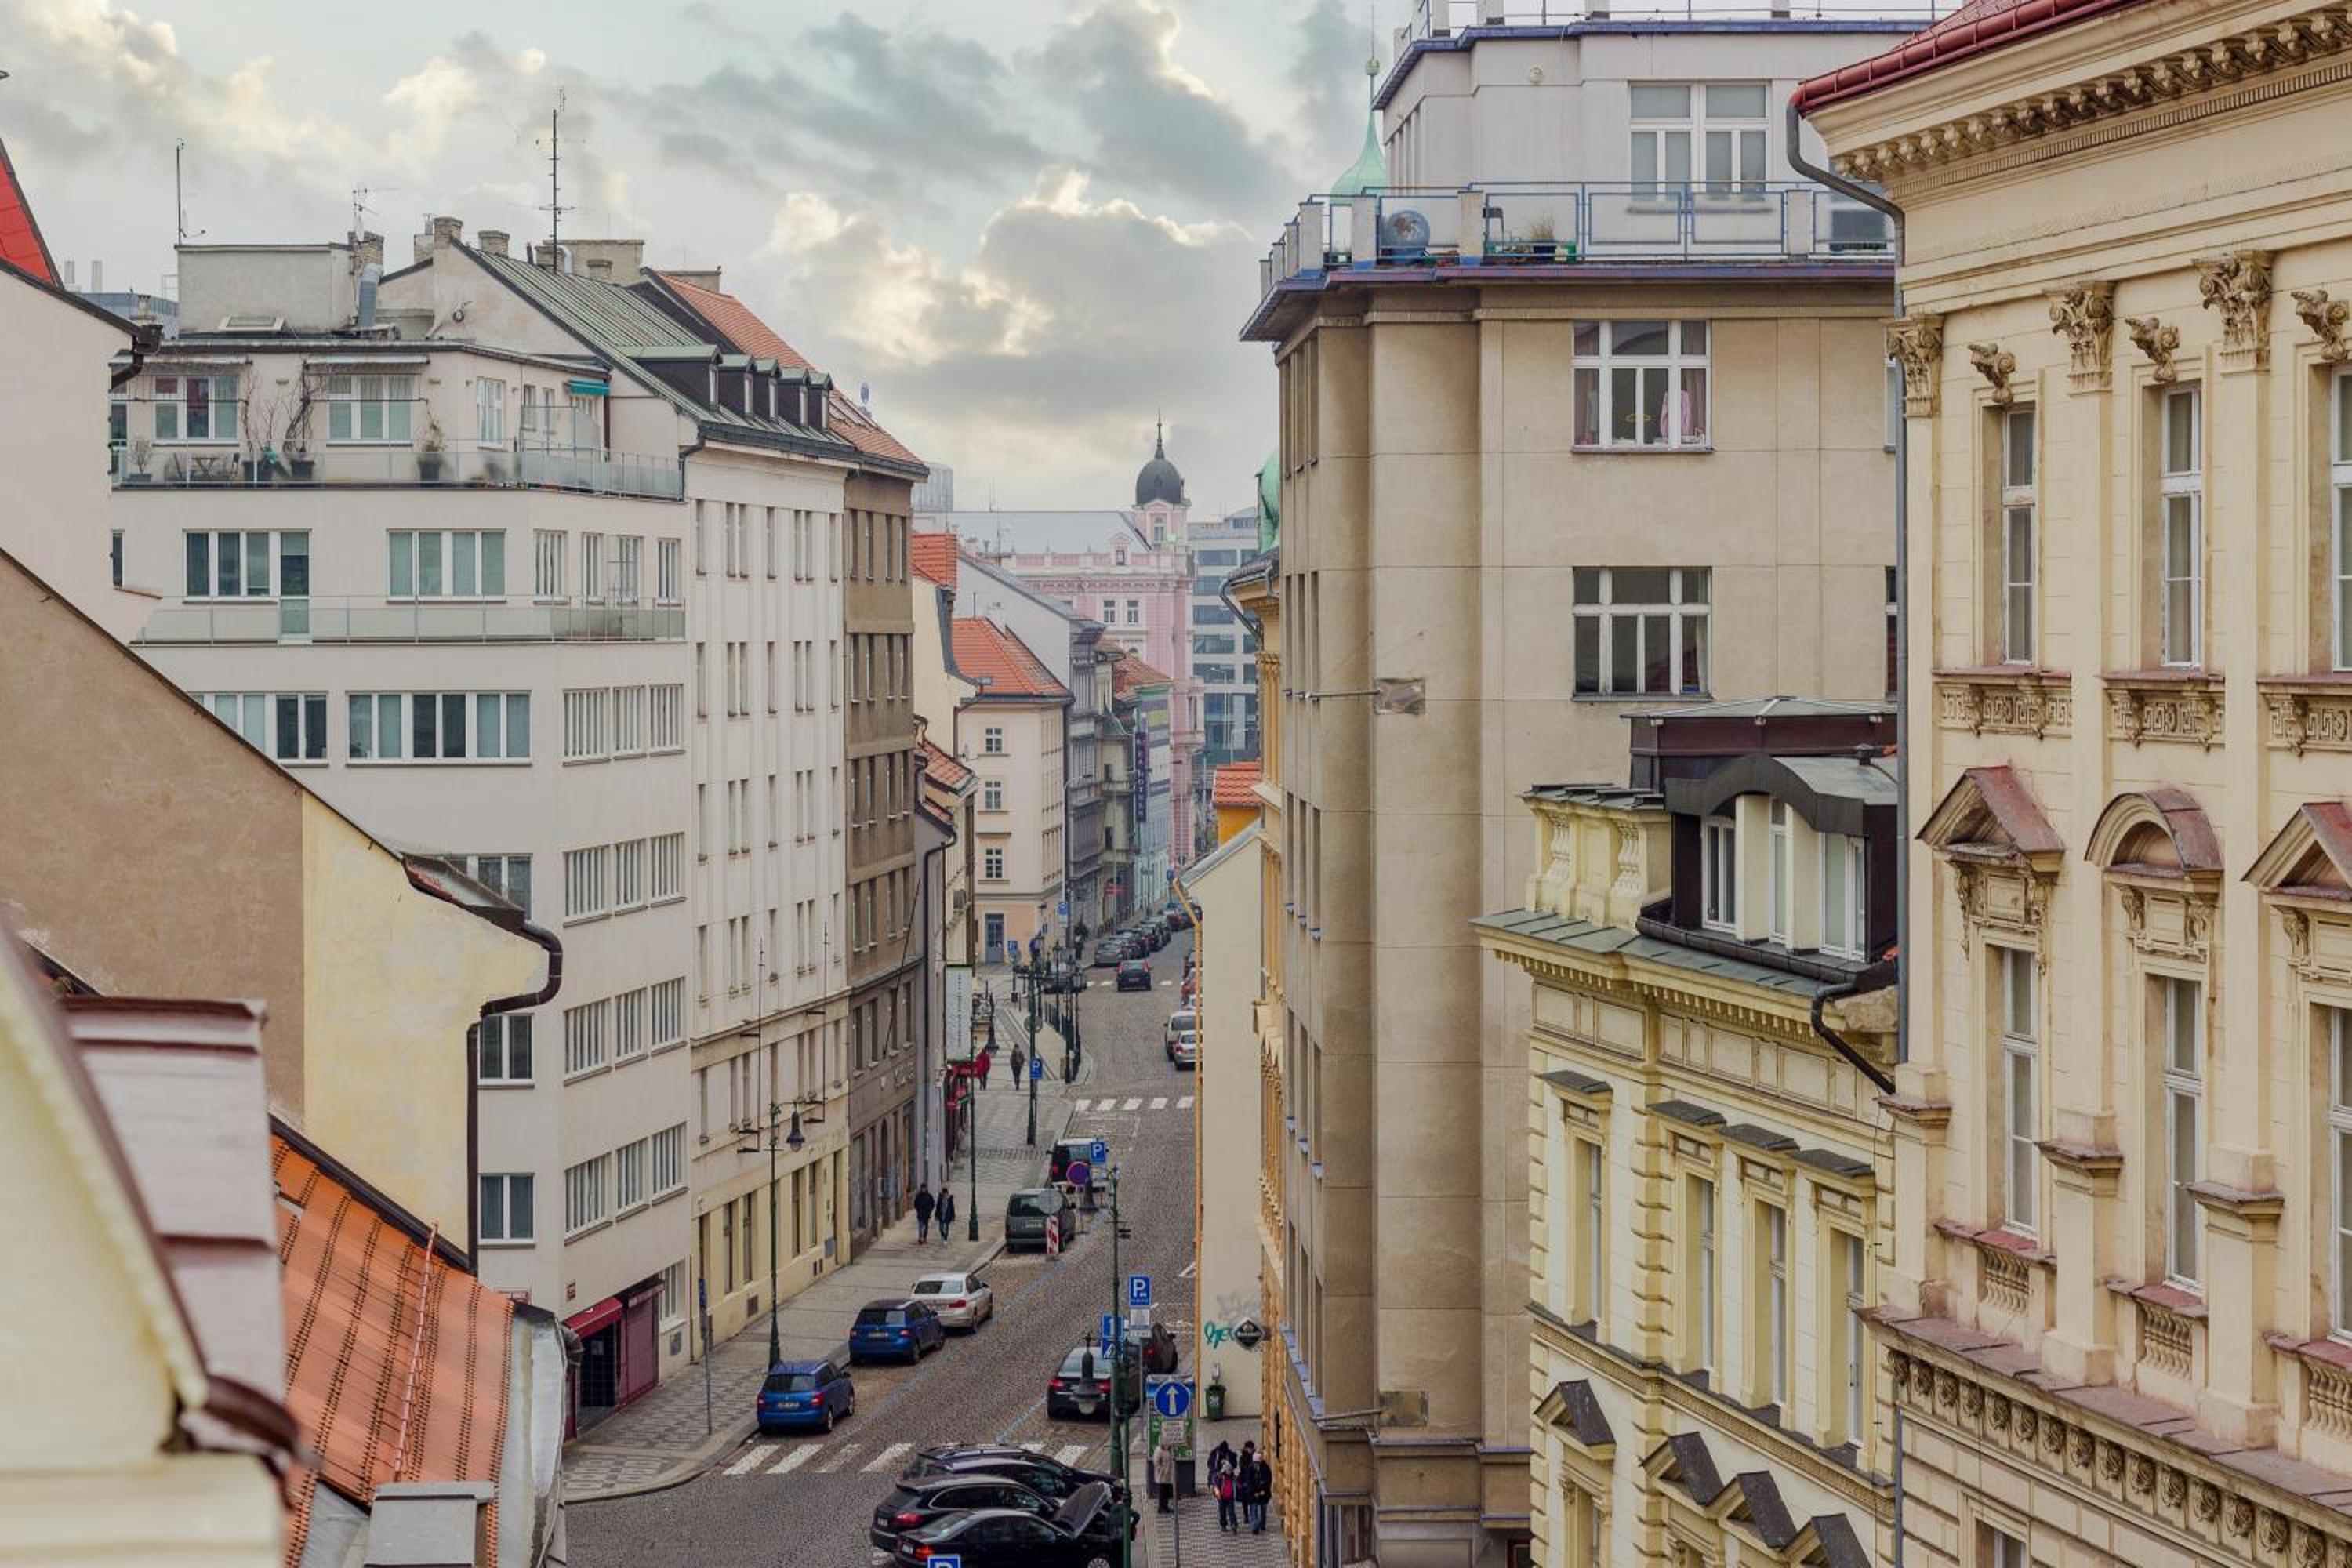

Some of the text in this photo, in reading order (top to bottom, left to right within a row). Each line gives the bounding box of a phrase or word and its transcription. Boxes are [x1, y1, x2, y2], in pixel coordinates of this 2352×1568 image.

[1033, 1060, 1040, 1071] P
[1093, 1144, 1102, 1156] P
[1133, 1279, 1145, 1297] P
